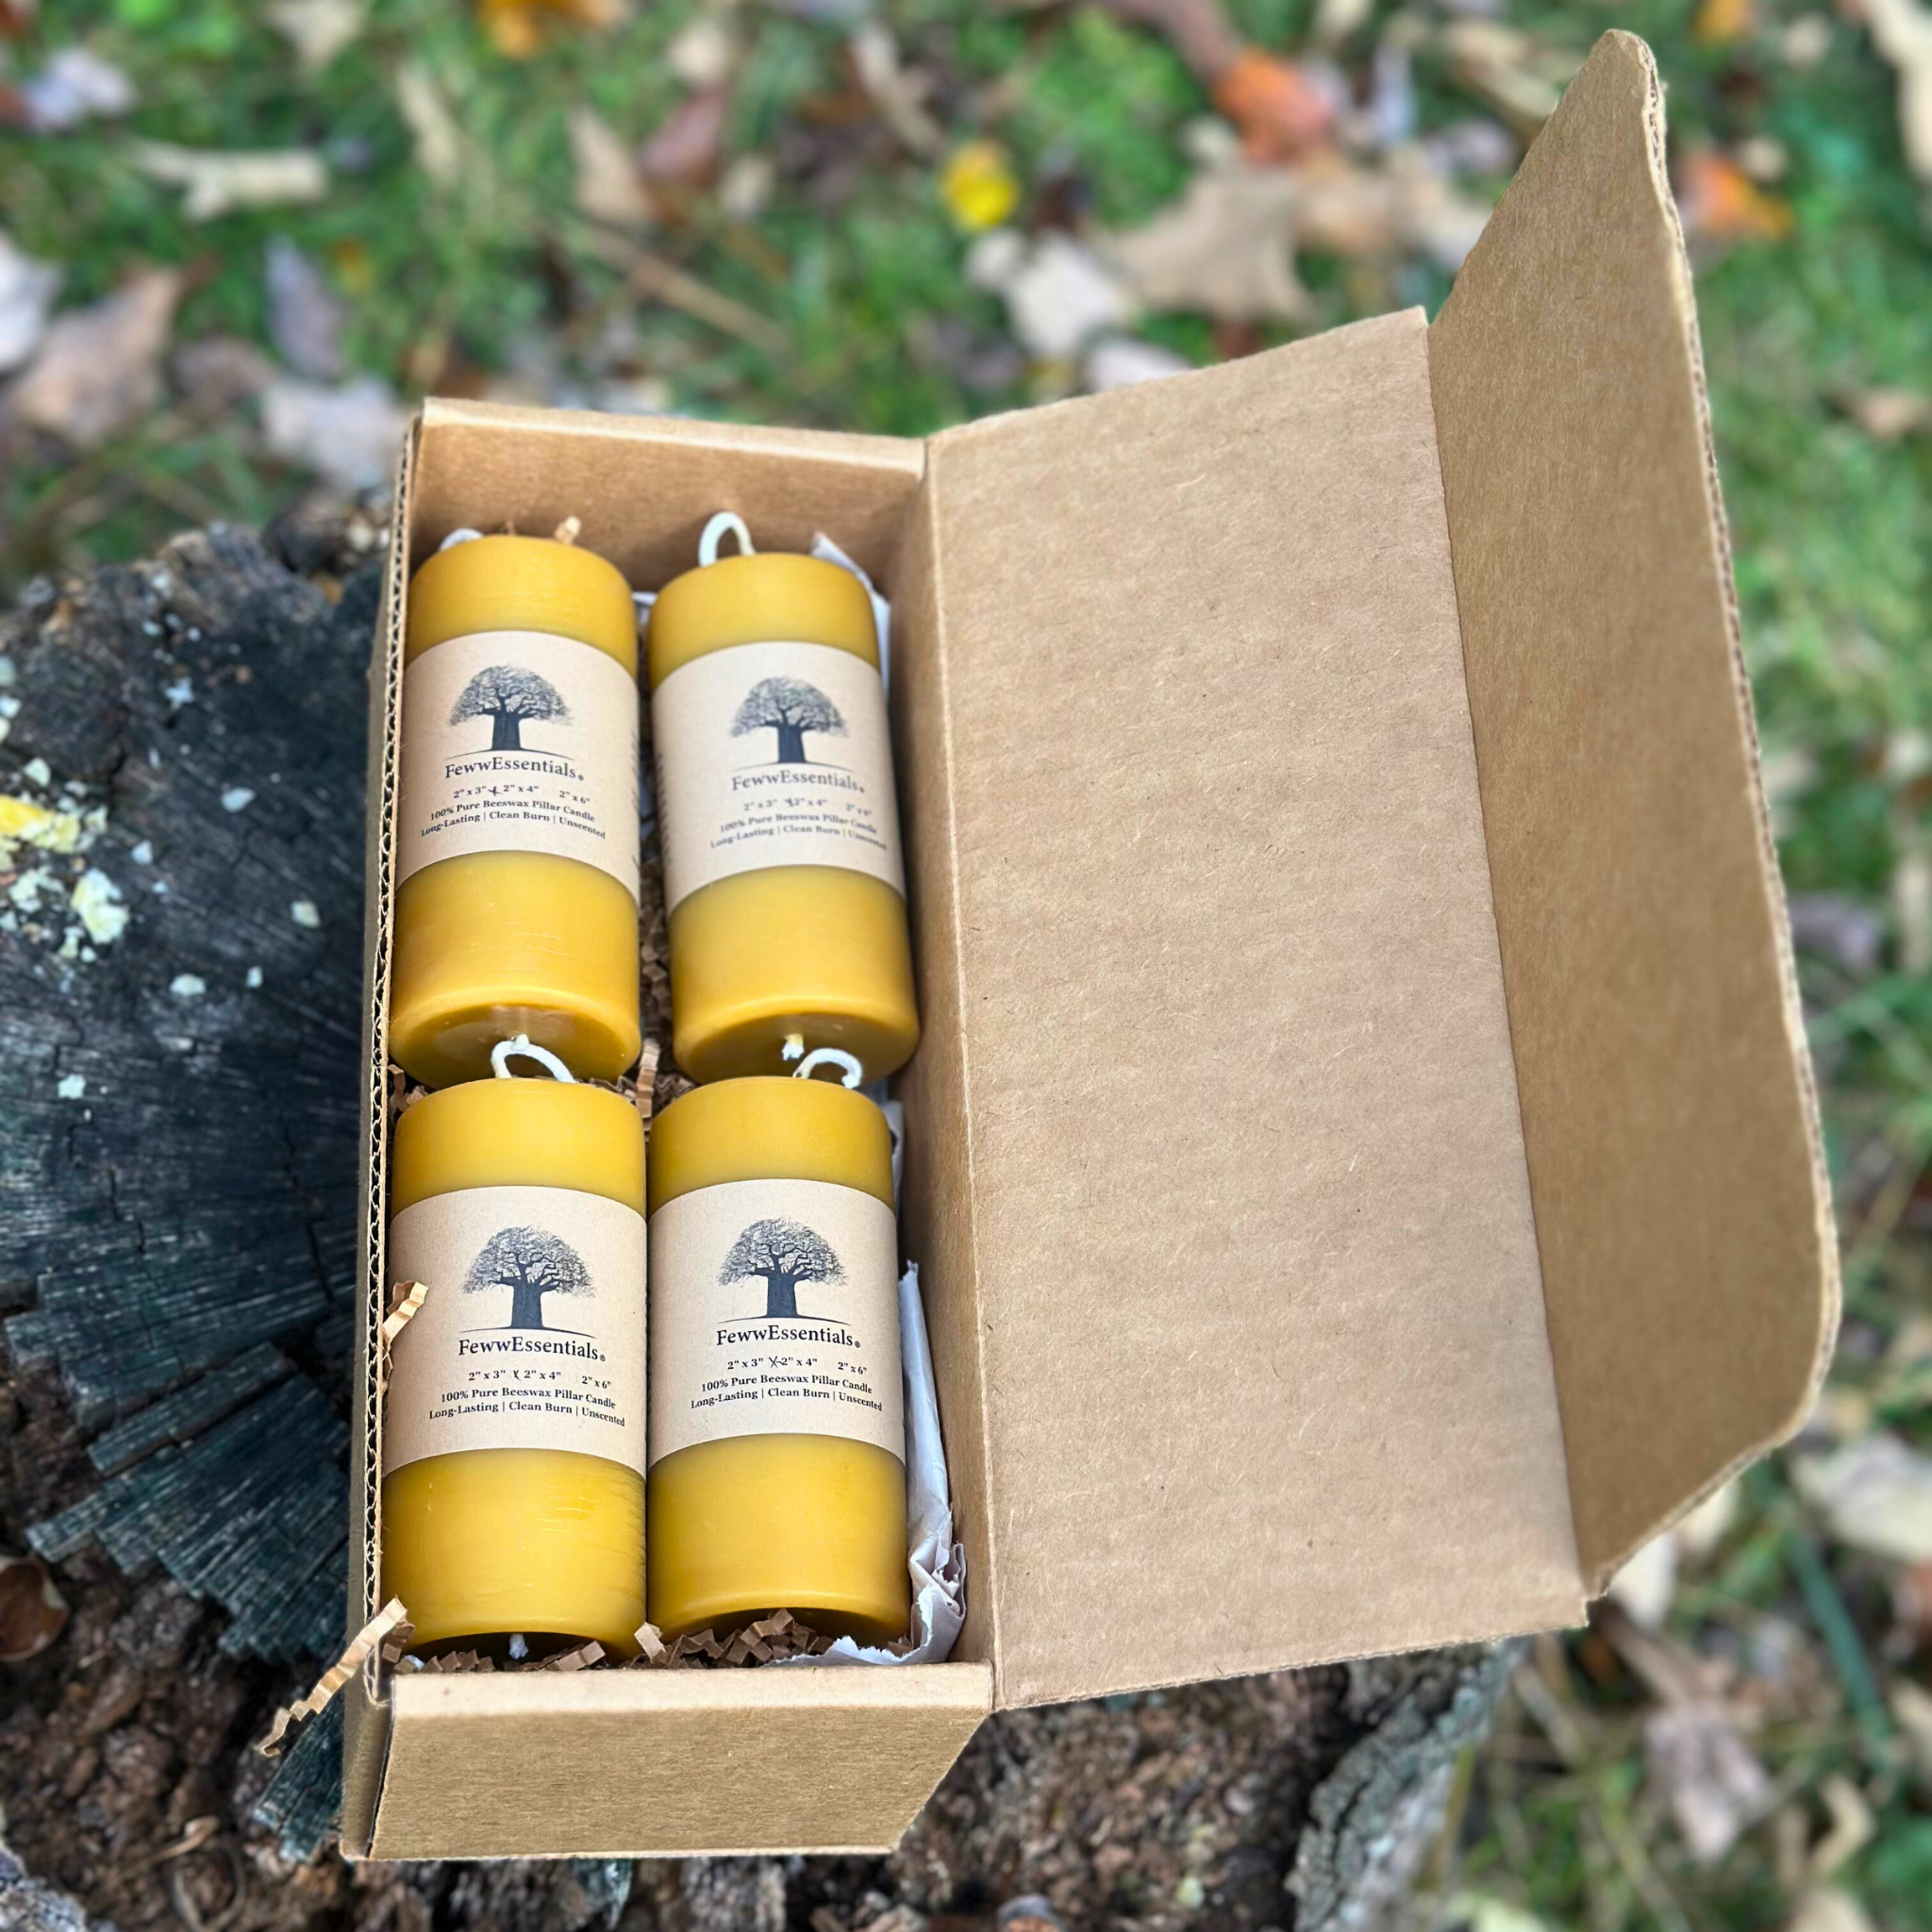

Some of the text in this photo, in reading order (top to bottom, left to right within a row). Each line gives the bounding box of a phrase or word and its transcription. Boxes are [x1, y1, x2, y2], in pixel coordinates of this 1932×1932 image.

[430, 808, 455, 821] 100%
[457, 803, 480, 811] Pure
[532, 801, 560, 811] Pillar
[563, 807, 595, 822] Candle
[422, 814, 480, 837] Long-Lasting
[523, 812, 550, 821] Burn
[559, 817, 606, 839] Unscented
[721, 820, 745, 832] 100%
[749, 815, 773, 824] Pure
[823, 814, 848, 824] Pillar
[851, 819, 877, 834] Candle
[711, 826, 774, 848] Long-Lasting
[783, 824, 812, 833] Clean
[816, 825, 840, 835] Burn
[849, 830, 887, 850] Unscented
[702, 1374, 872, 1394] 100% Pure Beeswax Pillar Candle
[441, 1388, 616, 1409] 100% Pure Beeswax Pillar Candle
[691, 1390, 758, 1408] Long-Lasting
[768, 1389, 800, 1397] Clean
[803, 1389, 829, 1398] Burn
[840, 1392, 882, 1411] Unscented
[429, 1402, 498, 1419] Long-Lasting
[509, 1402, 541, 1410] Clean
[545, 1403, 573, 1413] Burn
[582, 1407, 625, 1426] Unscented
